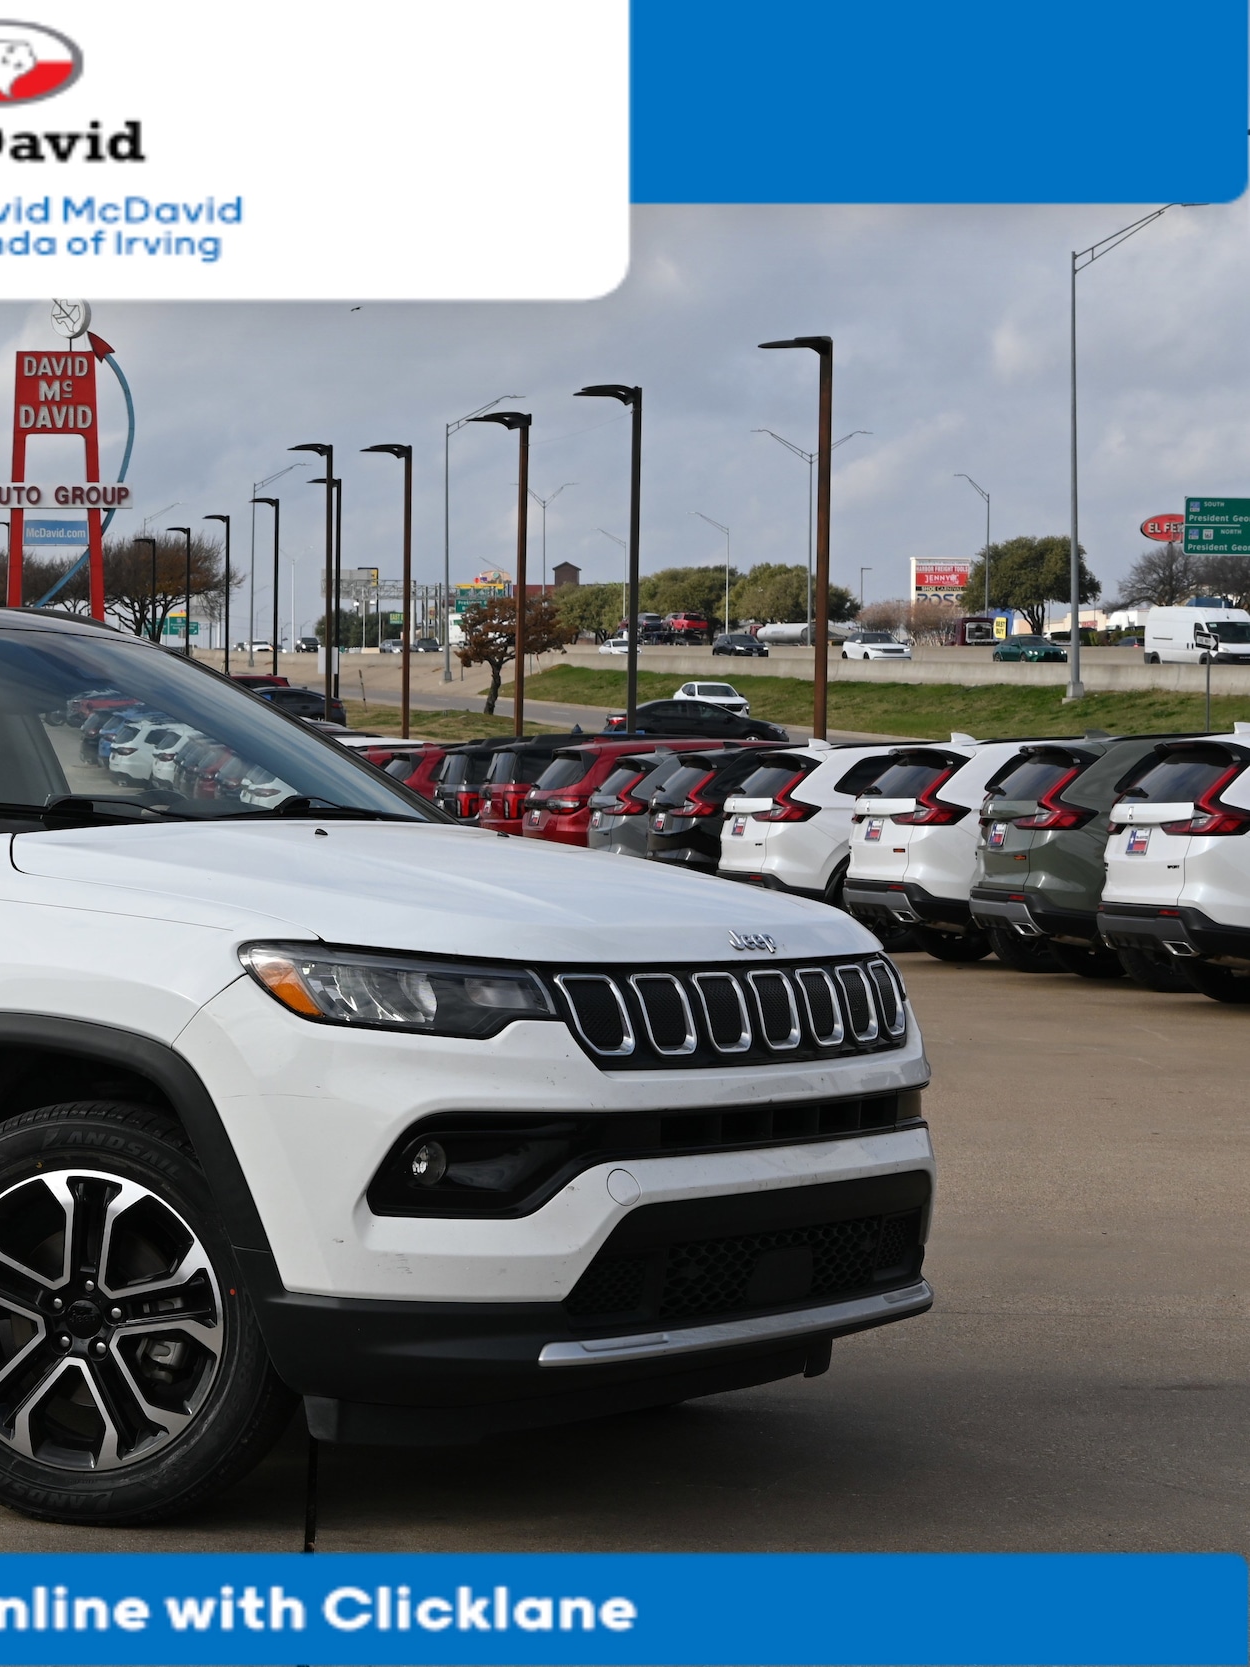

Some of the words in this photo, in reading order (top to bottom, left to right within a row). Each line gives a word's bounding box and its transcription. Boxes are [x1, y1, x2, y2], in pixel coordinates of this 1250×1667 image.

[23, 355, 89, 377] DAVID
[18, 404, 93, 429] DAVID
[54, 485, 130, 505] GROUP
[1148, 522, 1161, 533] EL
[1189, 514, 1229, 522] President
[25, 527, 86, 538] McDavid.com
[1188, 543, 1228, 551] President
[729, 930, 777, 954] Jeep
[41, 1128, 181, 1179] LANDSAIL
